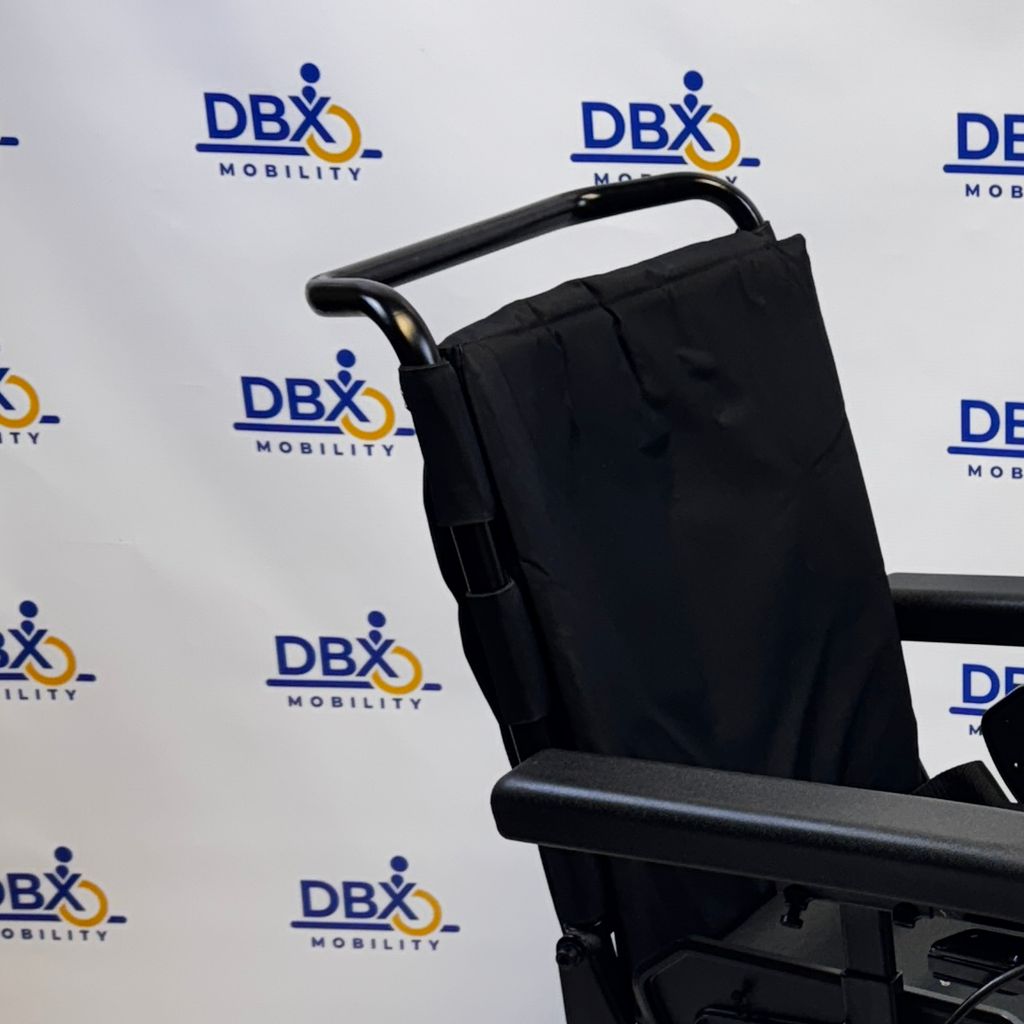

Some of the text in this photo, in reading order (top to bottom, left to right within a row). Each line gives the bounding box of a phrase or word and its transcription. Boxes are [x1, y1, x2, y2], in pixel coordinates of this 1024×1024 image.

[204, 92, 336, 143] DBX
[581, 101, 715, 152] DBX
[219, 163, 360, 181] MOBILITY
[241, 376, 370, 422] DBX
[256, 440, 394, 456] MOBILITY
[275, 635, 398, 678] DBX
[5, 689, 76, 701] ILITY
[288, 696, 421, 709] MOBILITY
[0, 873, 85, 912] BX
[300, 880, 418, 920] DBX
[1, 928, 107, 941] OBILITY
[311, 937, 439, 950] MOBILITY
